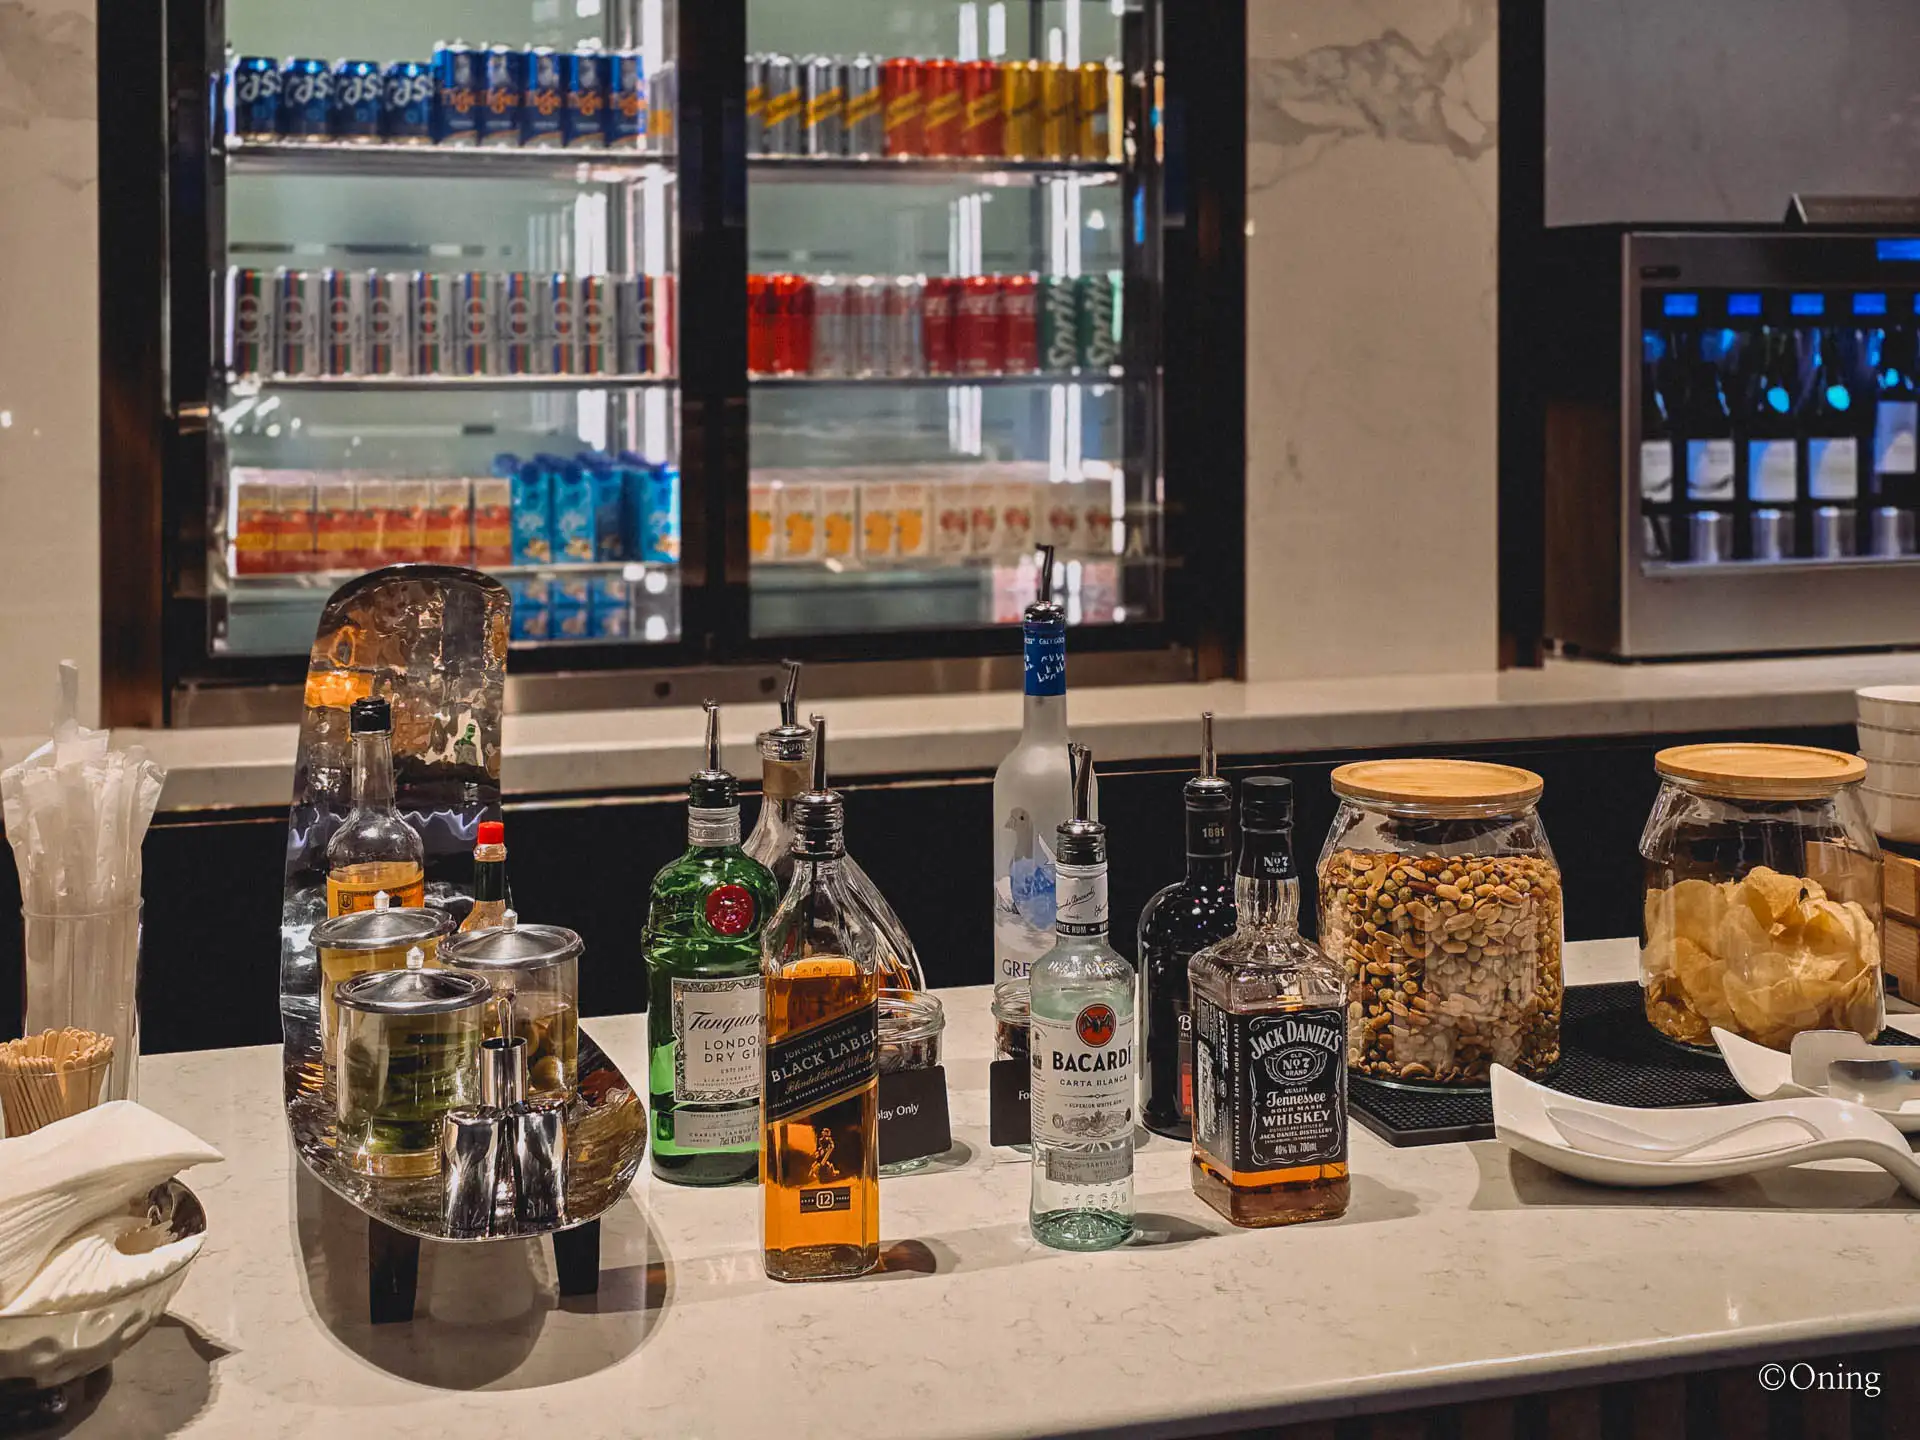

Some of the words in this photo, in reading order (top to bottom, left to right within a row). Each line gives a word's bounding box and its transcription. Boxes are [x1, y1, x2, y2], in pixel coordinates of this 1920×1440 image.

[1071, 923, 1087, 934] RUM
[704, 1035, 760, 1051] LONDO
[1249, 1027, 1286, 1060] JACK
[1286, 1020, 1342, 1054] DANIEL'S
[704, 1052, 735, 1063] DRY
[742, 1048, 760, 1060] GI
[770, 1051, 825, 1083] BLACK
[829, 1028, 878, 1060] LABEL
[1052, 1038, 1132, 1073] BACARDÍ
[1285, 1068, 1308, 1077] BRAND
[1059, 1078, 1092, 1087] CARTA
[1096, 1074, 1128, 1086] BLANCA
[1018, 1090, 1031, 1101] Fo
[1284, 1086, 1309, 1095] QUALITY
[1234, 1101, 1240, 1111] IN
[1266, 1092, 1327, 1108] Tennessee
[896, 1103, 919, 1116] Only
[1271, 1106, 1294, 1114] SOUR
[1296, 1103, 1322, 1112] MASH
[1262, 1109, 1330, 1127] WHISKEY
[1259, 1132, 1276, 1140] JACK
[1276, 1130, 1298, 1138] DANIEL
[1299, 1127, 1333, 1136] DISTILLERY
[1274, 1144, 1288, 1156] 40%
[819, 1194, 831, 1205] 12
